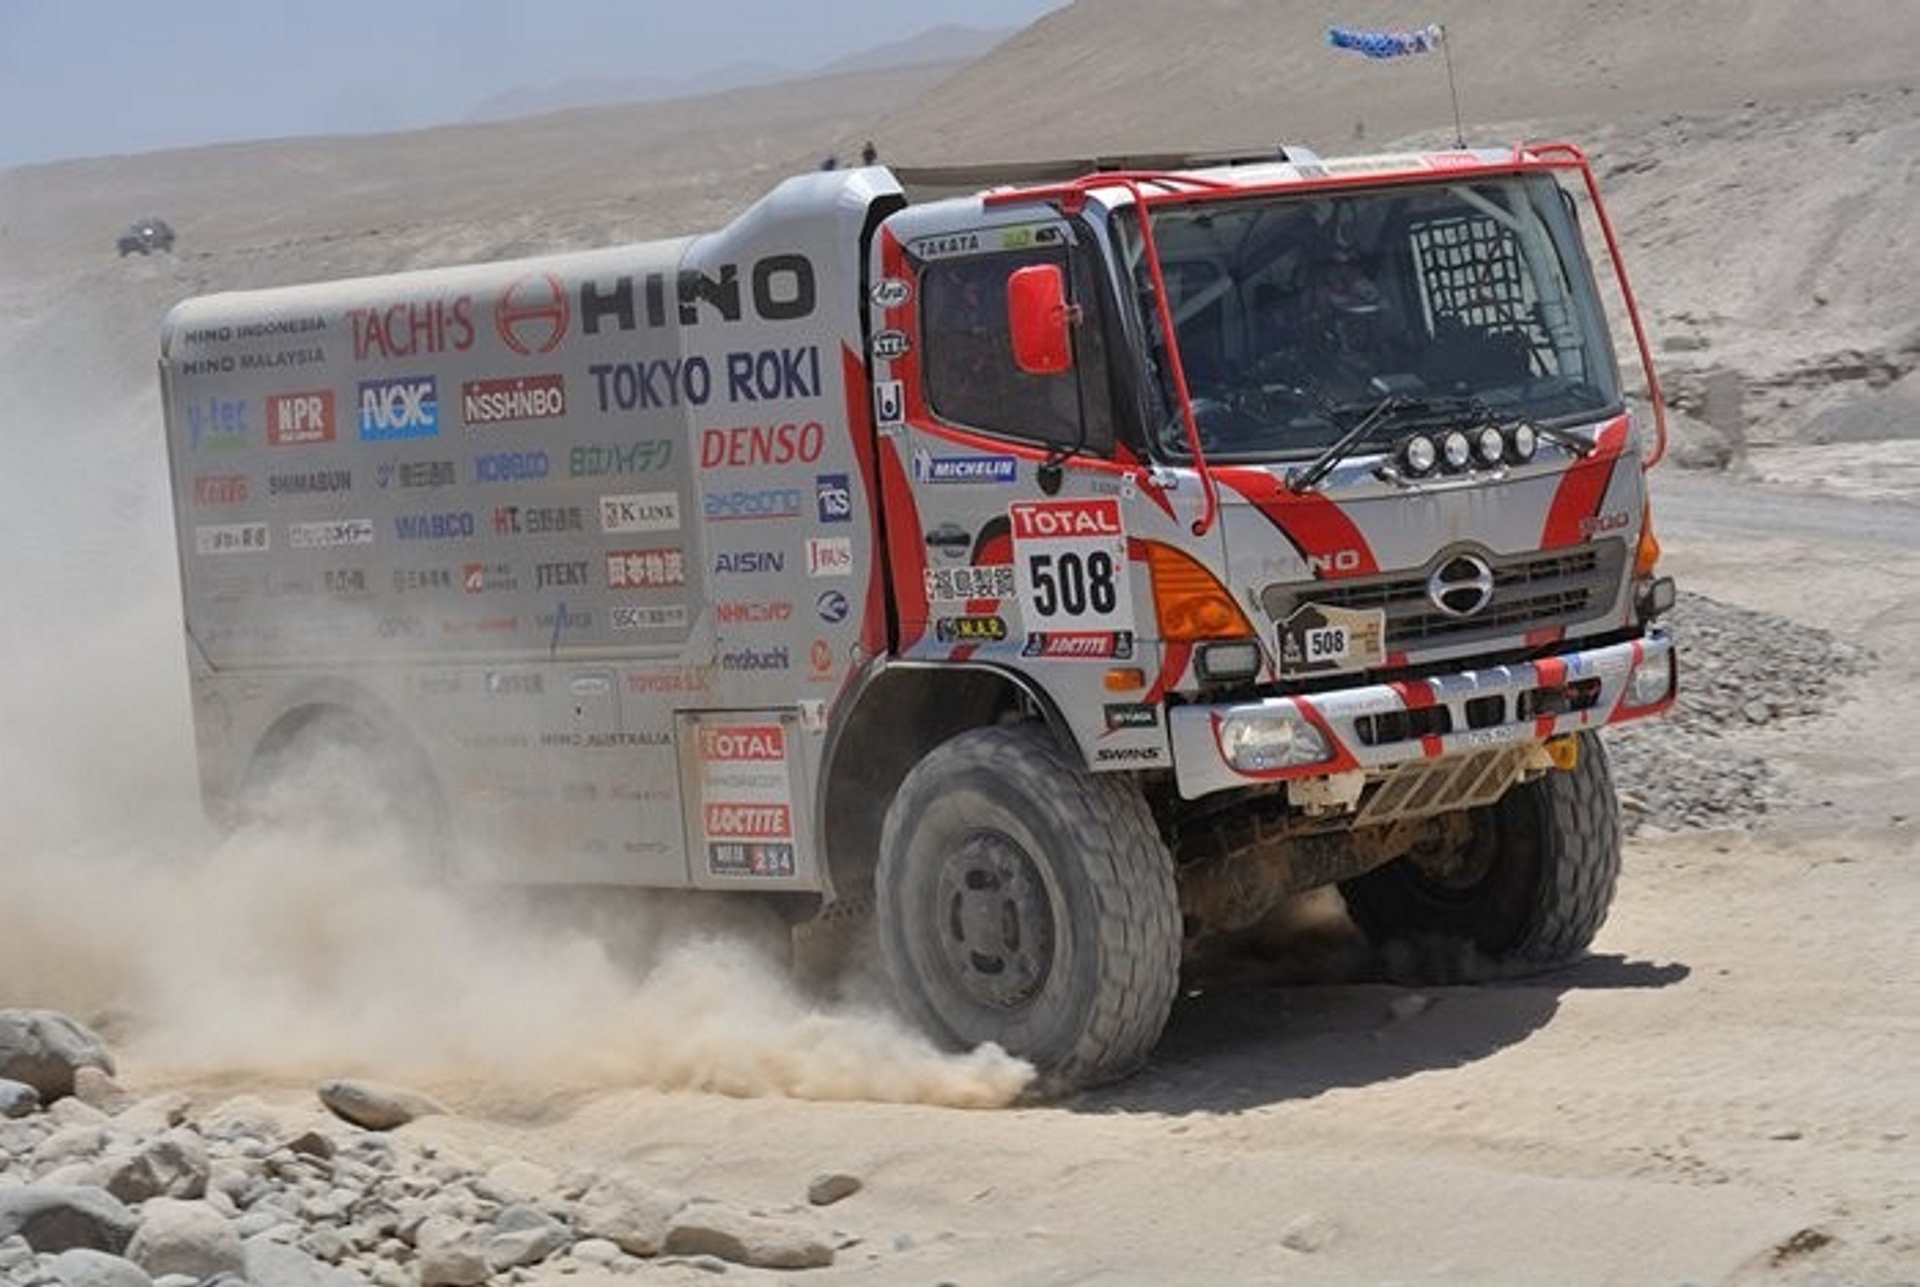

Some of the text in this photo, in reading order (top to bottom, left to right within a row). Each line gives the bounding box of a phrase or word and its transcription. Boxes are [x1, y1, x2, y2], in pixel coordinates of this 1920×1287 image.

[919, 235, 979, 256] TAKATA
[580, 254, 816, 334] HINO
[185, 316, 327, 345] HINO INDONESIA
[182, 349, 326, 375] HINO MALAYSIA
[589, 346, 822, 412] TOKYO ROKI
[701, 422, 824, 469] DENSO
[933, 460, 1014, 477] MICHELIN
[394, 512, 475, 540] WABCO
[1016, 507, 1119, 534] TOTAL
[715, 552, 785, 574] AISIN
[1029, 551, 1117, 617] 508
[1049, 637, 1107, 654] LOCTITE
[1312, 631, 1345, 656] 508
[702, 730, 783, 757] TOTAL
[710, 807, 784, 834] LOCTITE
